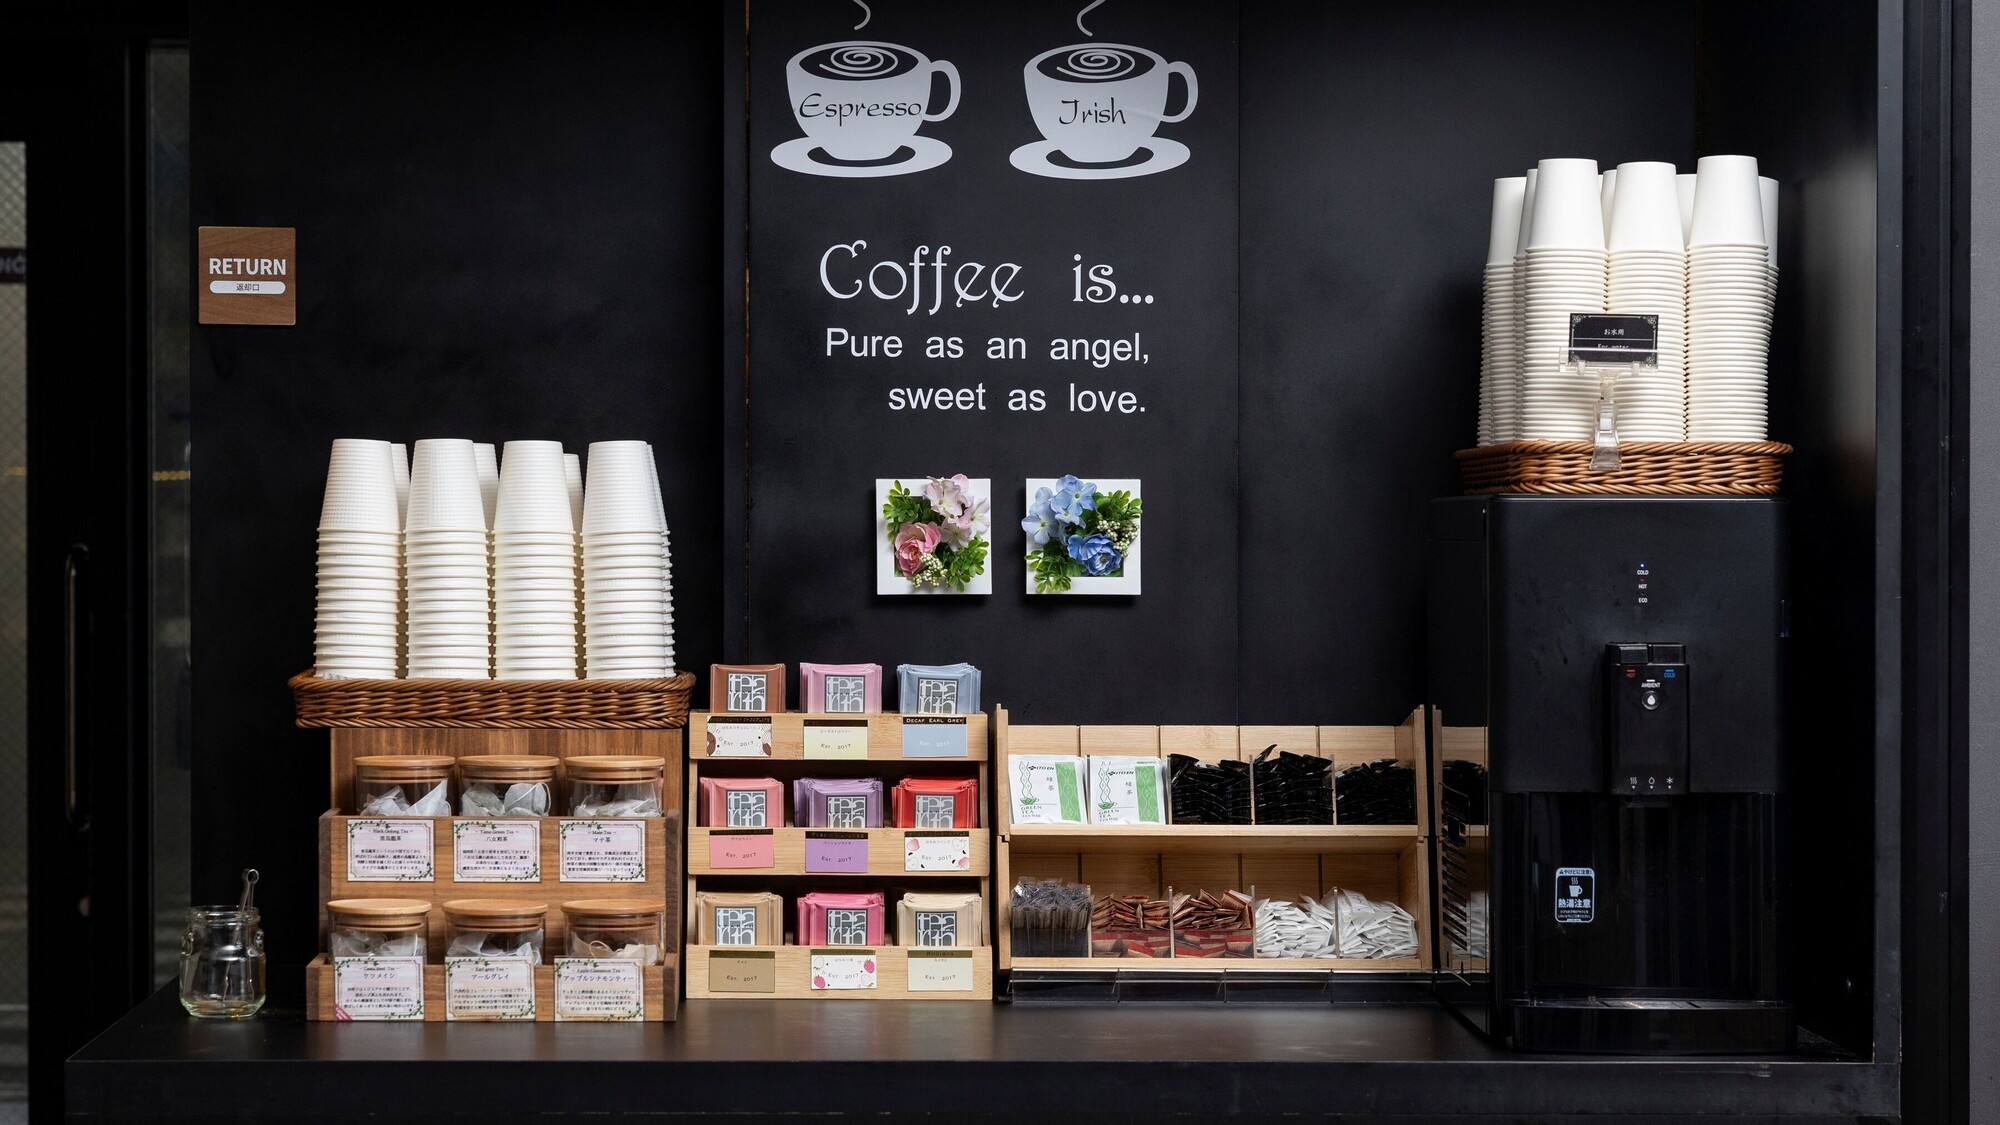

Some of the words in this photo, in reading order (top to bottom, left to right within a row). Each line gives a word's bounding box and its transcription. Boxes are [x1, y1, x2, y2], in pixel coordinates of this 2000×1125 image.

[799, 92, 922, 127] Espresso
[209, 258, 286, 275] RETURN
[820, 239, 1025, 315] Coffee
[1072, 254, 1154, 303] is...
[236, 283, 259, 292] 返却口
[826, 327, 903, 357] Pure
[925, 336, 964, 359] as
[987, 336, 1026, 359] an
[1050, 332, 1149, 368] angel,
[1604, 328, 1625, 336] お水用
[889, 382, 986, 411] sweet
[1008, 388, 1047, 411] as
[1070, 383, 1146, 413] love.
